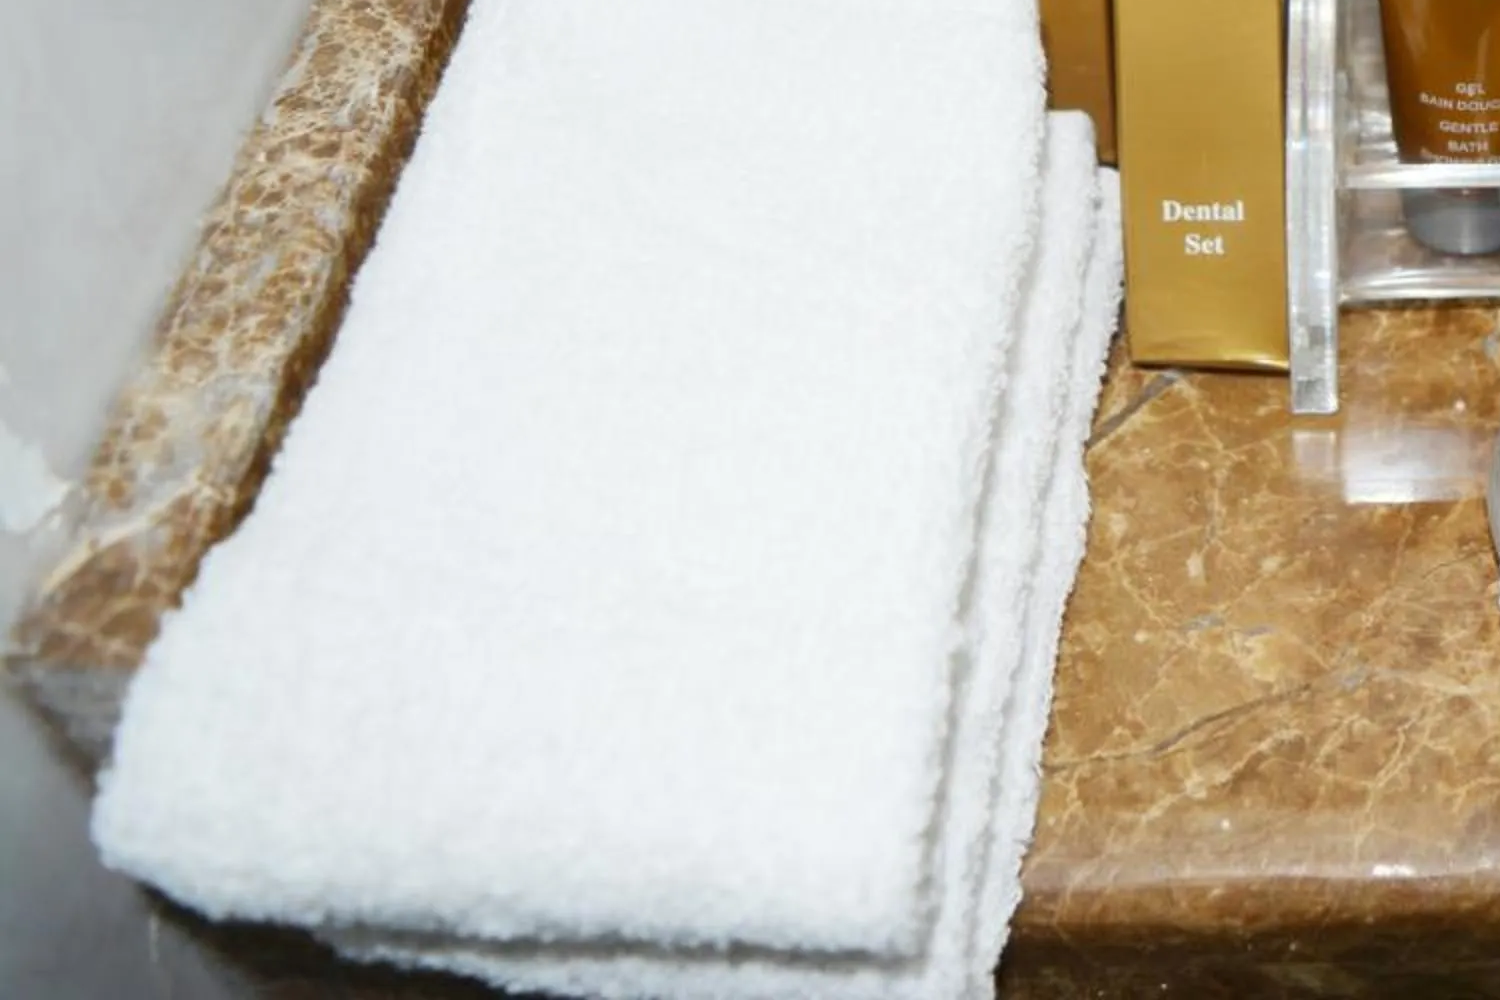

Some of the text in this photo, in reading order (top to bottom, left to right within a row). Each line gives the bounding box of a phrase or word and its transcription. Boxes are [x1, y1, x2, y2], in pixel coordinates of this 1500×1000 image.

[1455, 82, 1486, 95] GEL
[1420, 92, 1453, 109] BAIN
[1439, 120, 1499, 133] GENTLE
[1447, 140, 1489, 152] BATH
[1162, 199, 1245, 221] Dental
[1184, 233, 1225, 255] Set
